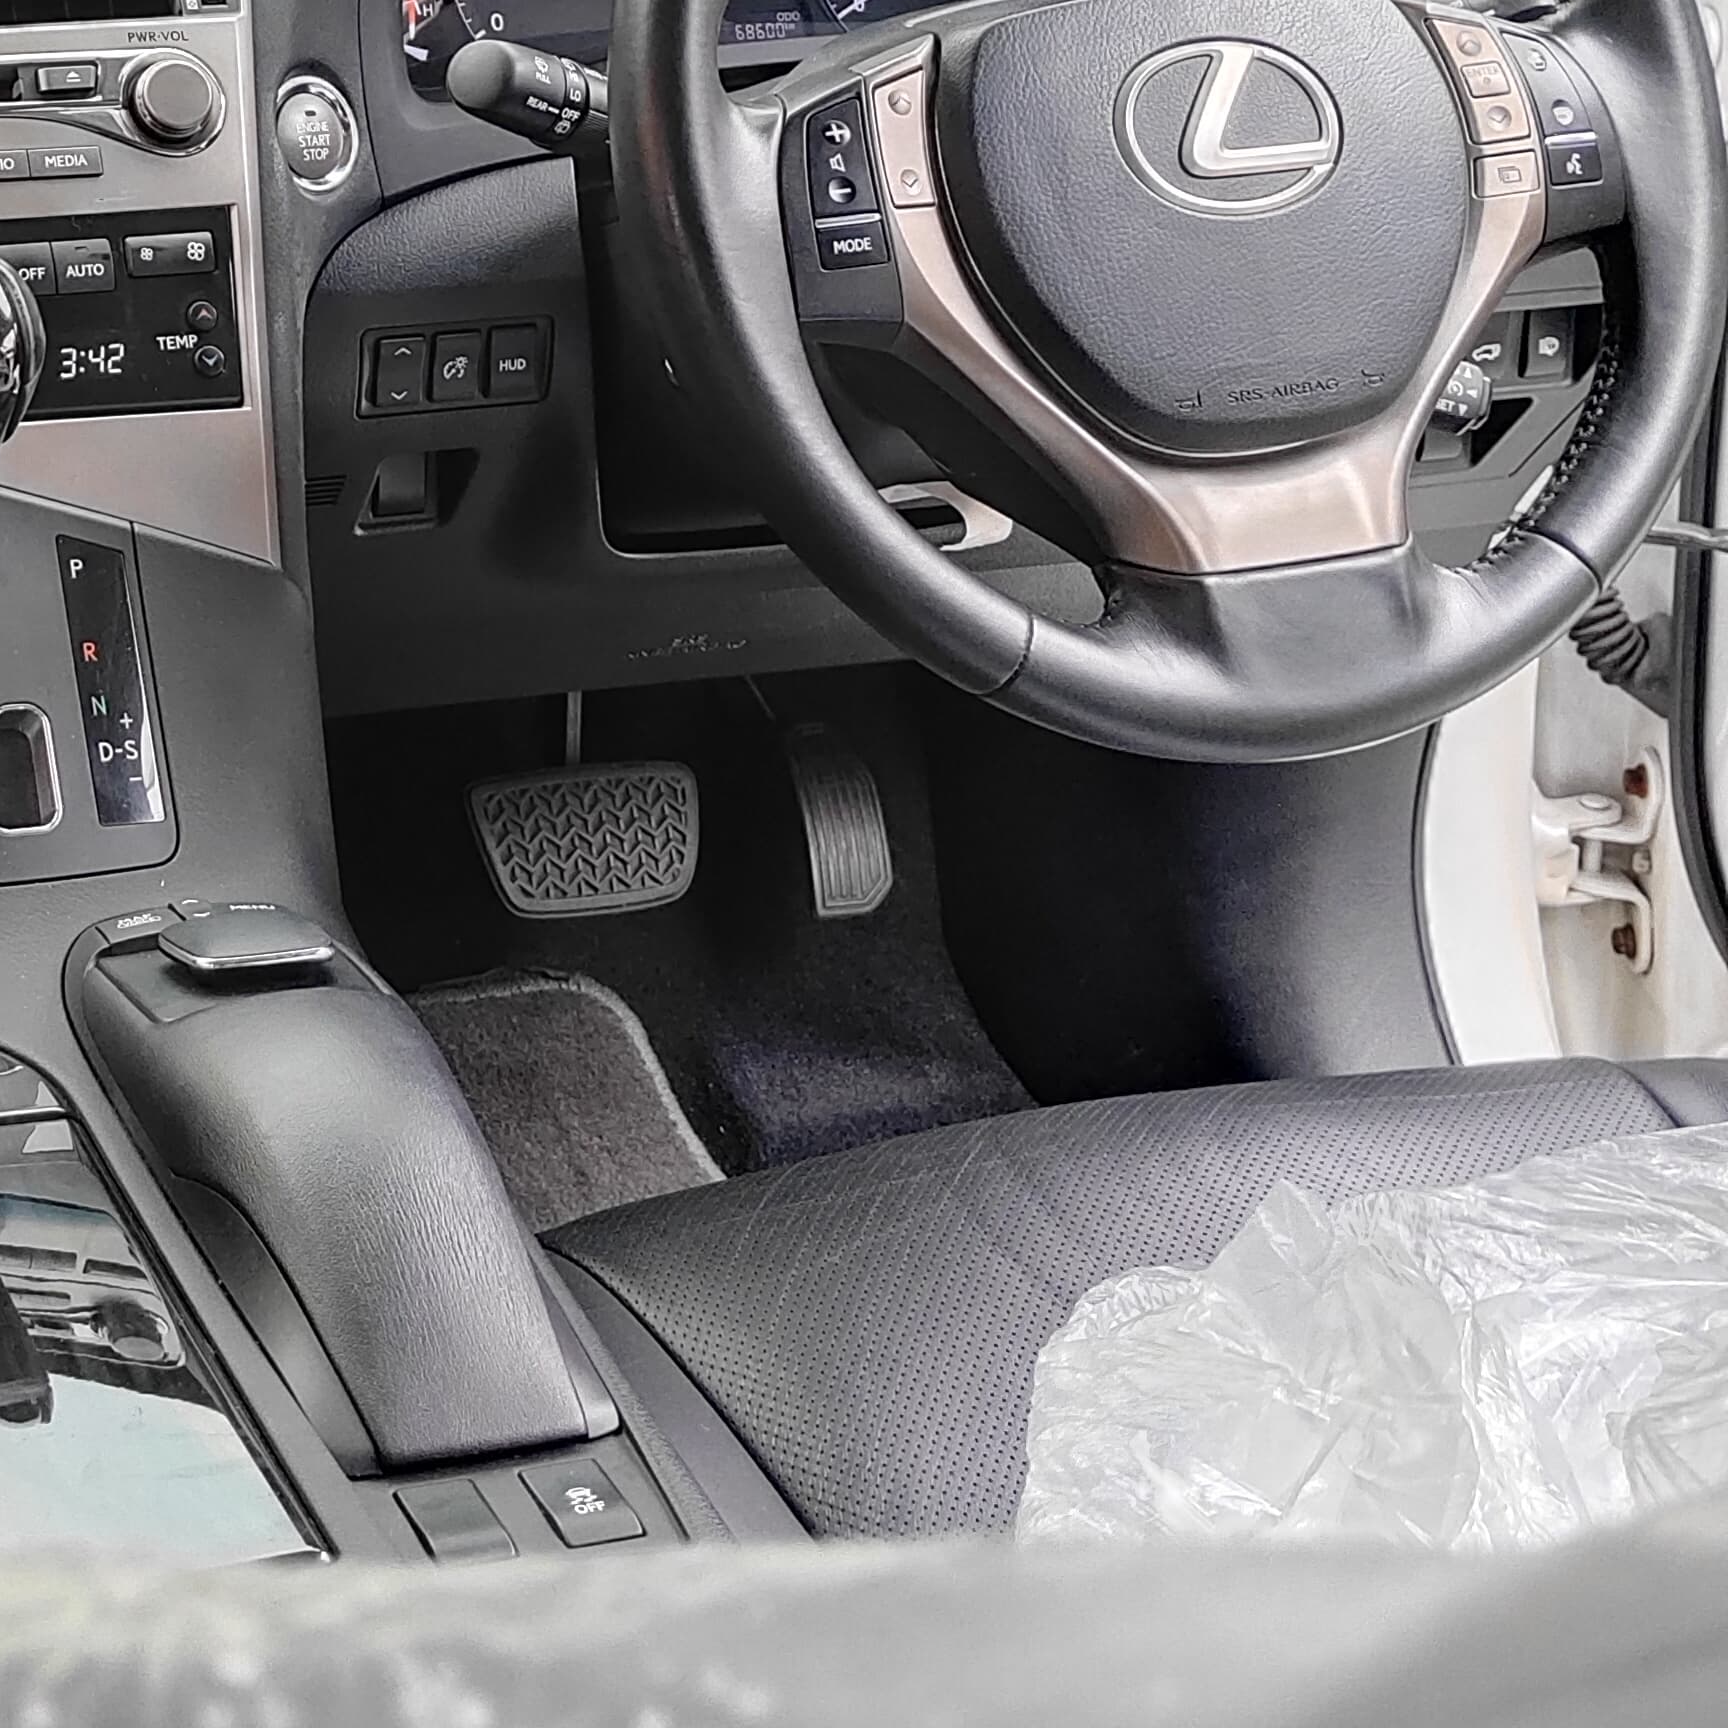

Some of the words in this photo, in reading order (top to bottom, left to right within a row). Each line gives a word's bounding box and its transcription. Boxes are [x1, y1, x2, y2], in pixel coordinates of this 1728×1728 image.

[423, 4, 434, 17] H
[776, 11, 800, 22] ODO
[490, 13, 504, 31] 0
[735, 22, 785, 41] 68600
[526, 95, 549, 112] REAR
[569, 87, 582, 103] LO
[561, 107, 581, 122] OFF
[296, 121, 329, 134] ENGINE
[298, 134, 331, 148] START
[44, 153, 88, 169] MEDIA
[303, 148, 330, 161] STOP
[833, 237, 873, 255] MODE
[18, 266, 46, 281] OFF
[66, 262, 105, 278] AUTO
[156, 333, 198, 351] TEMP
[58, 343, 125, 379] 3:42
[498, 356, 527, 373] HUD
[69, 559, 84, 579] P
[82, 642, 98, 662] R
[90, 695, 108, 717] N
[574, 1500, 606, 1515] OFF
